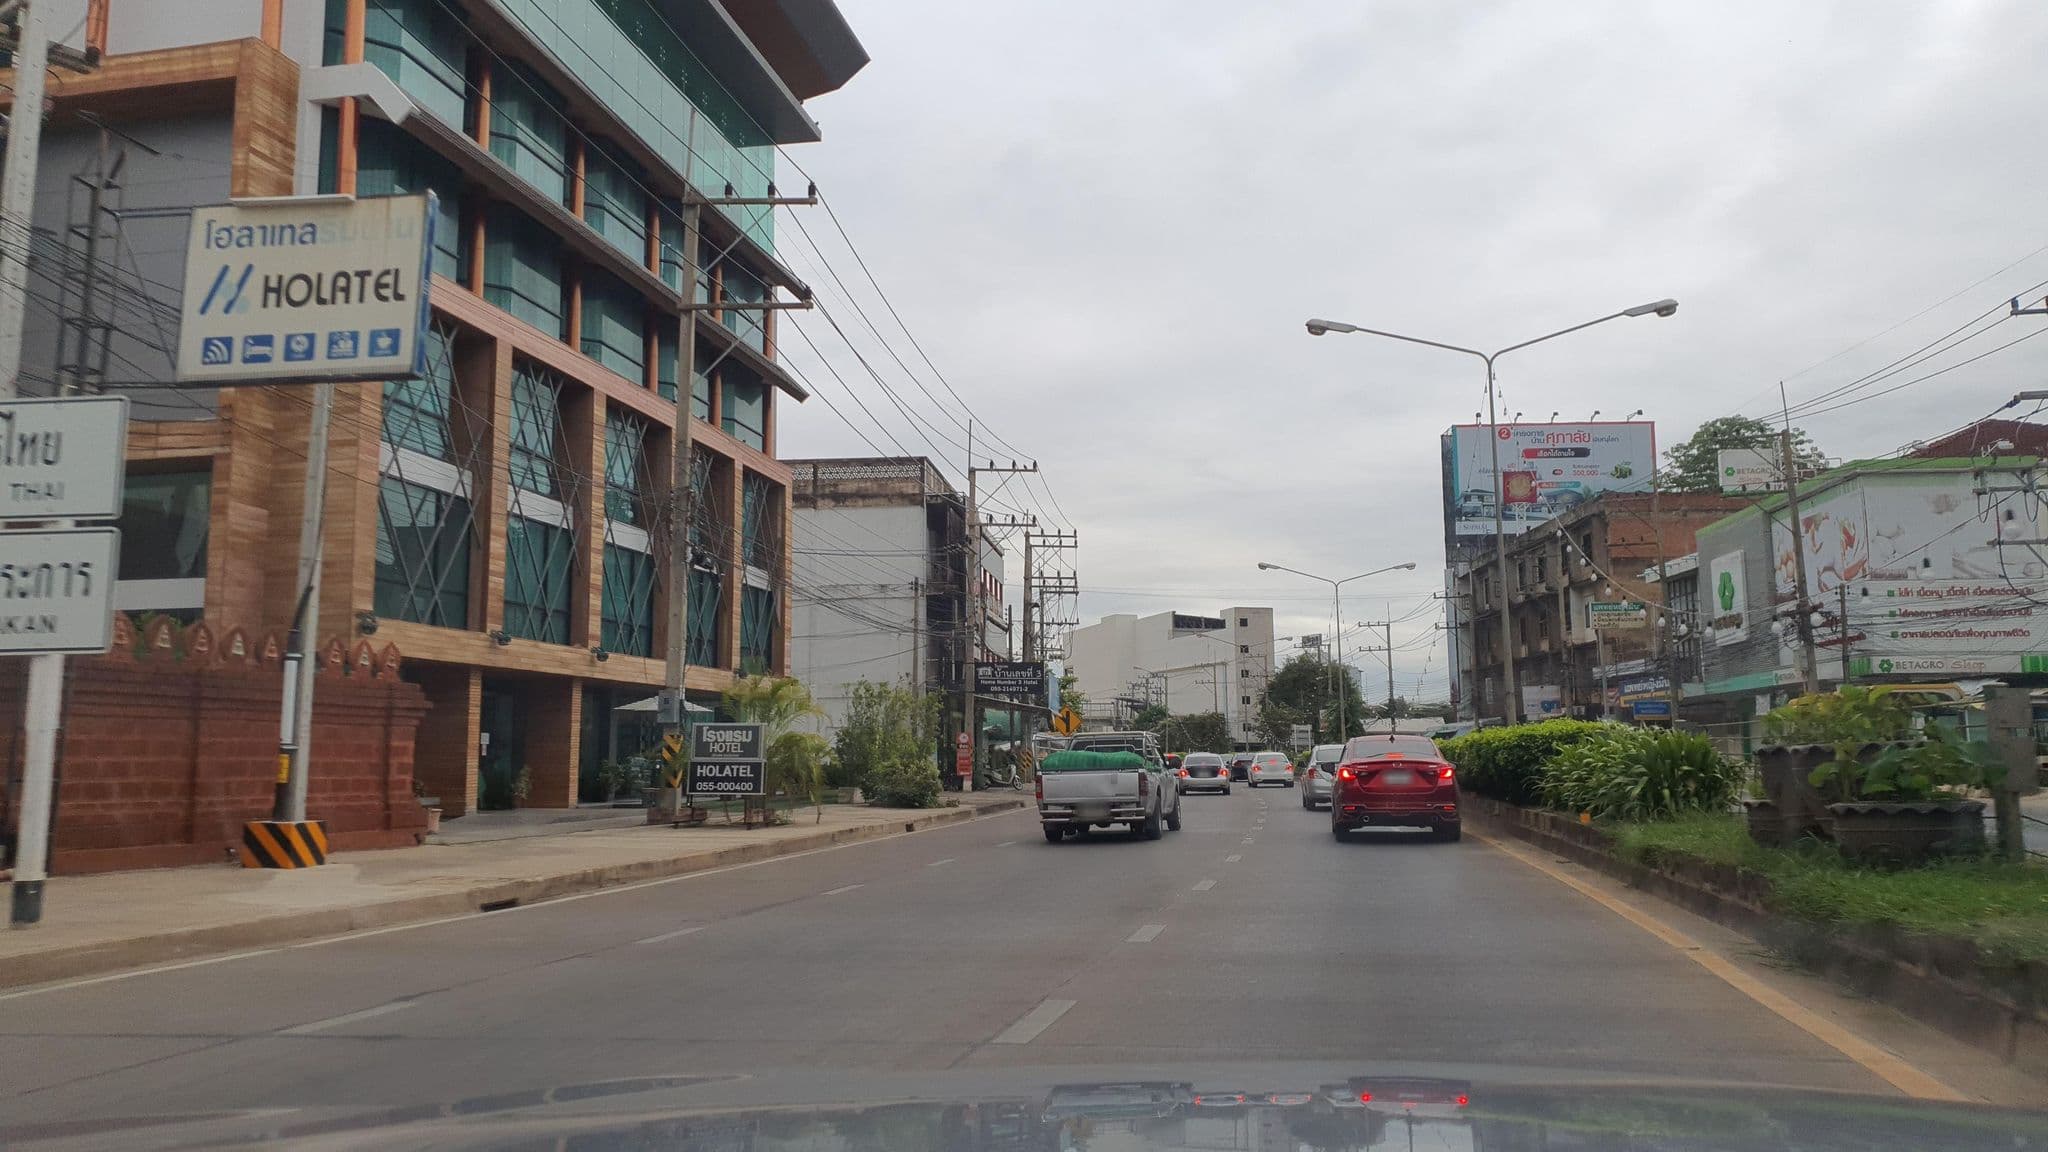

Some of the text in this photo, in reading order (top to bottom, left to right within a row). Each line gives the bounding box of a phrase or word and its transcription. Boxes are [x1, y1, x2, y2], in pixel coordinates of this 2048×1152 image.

[262, 268, 406, 309] HOLATEL
[1895, 660, 1945, 670] BETAGRO
[702, 726, 753, 743] โรงแรม
[709, 742, 744, 753] HOTEL
[696, 765, 754, 777] HOLATEL
[696, 782, 754, 791] 055-000400
